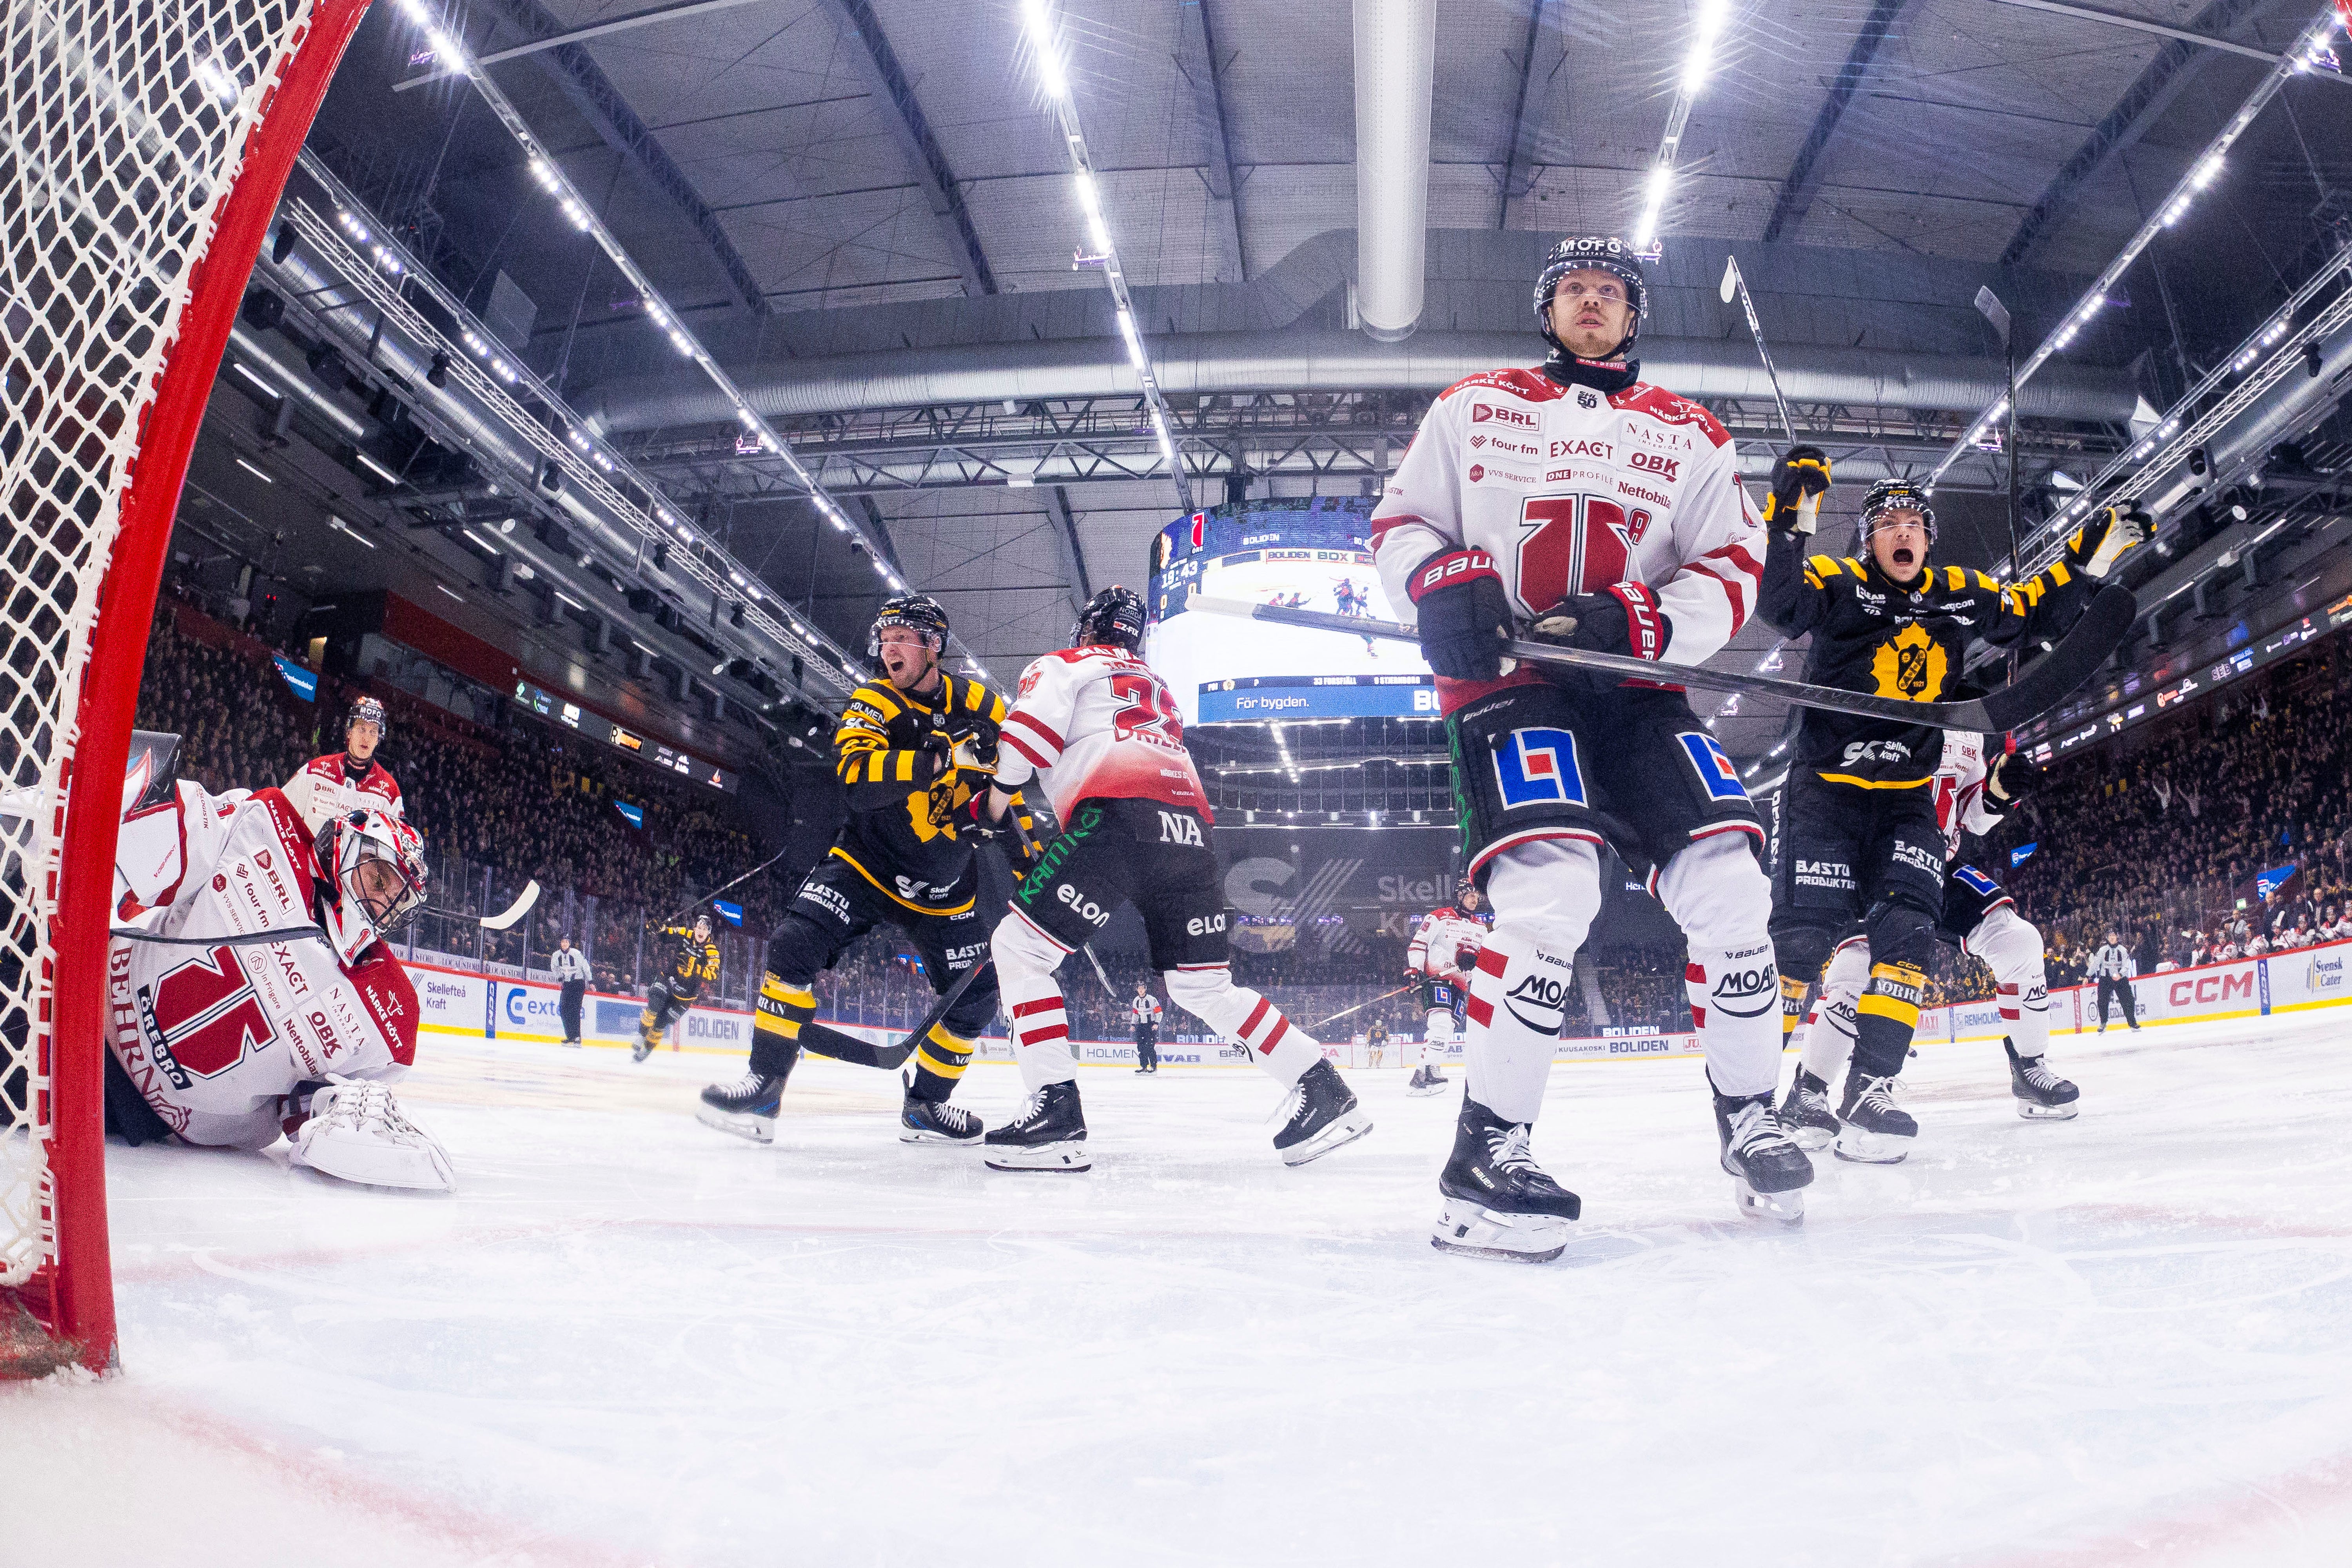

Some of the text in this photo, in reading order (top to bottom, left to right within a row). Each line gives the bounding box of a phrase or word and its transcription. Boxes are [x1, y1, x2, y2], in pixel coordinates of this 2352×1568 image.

[1455, 377, 1529, 395] NÄRKE KÖTT
[1495, 408, 1536, 426] BRL
[1650, 406, 1713, 434] NÄRKE KÖTT
[1627, 423, 1692, 450] NASTA
[1492, 437, 1538, 455] four fm
[1550, 440, 1613, 460] EXACT
[1631, 452, 1681, 477] OBK
[1488, 470, 1537, 484] VVS SERVICE
[1547, 471, 1614, 486] ONE PROFILE
[1161, 561, 1198, 589] 19:43
[1160, 594, 1168, 610] 0
[1121, 623, 1139, 637] Z-FIX
[1313, 677, 1323, 685] 33
[2211, 664, 2231, 681] SEB
[359, 706, 382, 718] MOFO
[850, 701, 886, 724] HOLMEN
[1236, 696, 1310, 711] För bygden.
[1962, 744, 1976, 757] OBK
[322, 786, 336, 794] BRL
[268, 800, 302, 870] NÄRKE KÖTT
[1158, 810, 1204, 847] NA
[1895, 840, 1942, 873] BASTU
[1796, 860, 1850, 877] BASTU
[267, 869, 292, 911] BRL
[805, 882, 850, 910] BASTU
[222, 893, 246, 935] VVS SERVIC
[244, 882, 270, 928] four fm
[799, 891, 851, 925] PRODUKTER
[950, 911, 975, 920] CCM
[1896, 960, 1922, 971] CCM
[2315, 956, 2343, 973] Svensk
[427, 981, 466, 998] Skellefteå
[2169, 971, 2254, 1007] CCM
[2319, 975, 2343, 987] Cater
[265, 979, 281, 1010] Frigore
[426, 996, 446, 1009] Kraft
[110, 945, 165, 1096] BEHRN
[330, 986, 366, 1047] NASTA
[365, 984, 403, 1049] NÄRKE KÖTT
[311, 1011, 343, 1056] OBK
[688, 1014, 740, 1040] BOLIDEN
[1603, 1026, 1660, 1037] BOLIDEN
[140, 995, 183, 1084] ÖREBRO
[1610, 1039, 1669, 1053] BOLIDEN
[1087, 1048, 1139, 1059] HOLMEN
